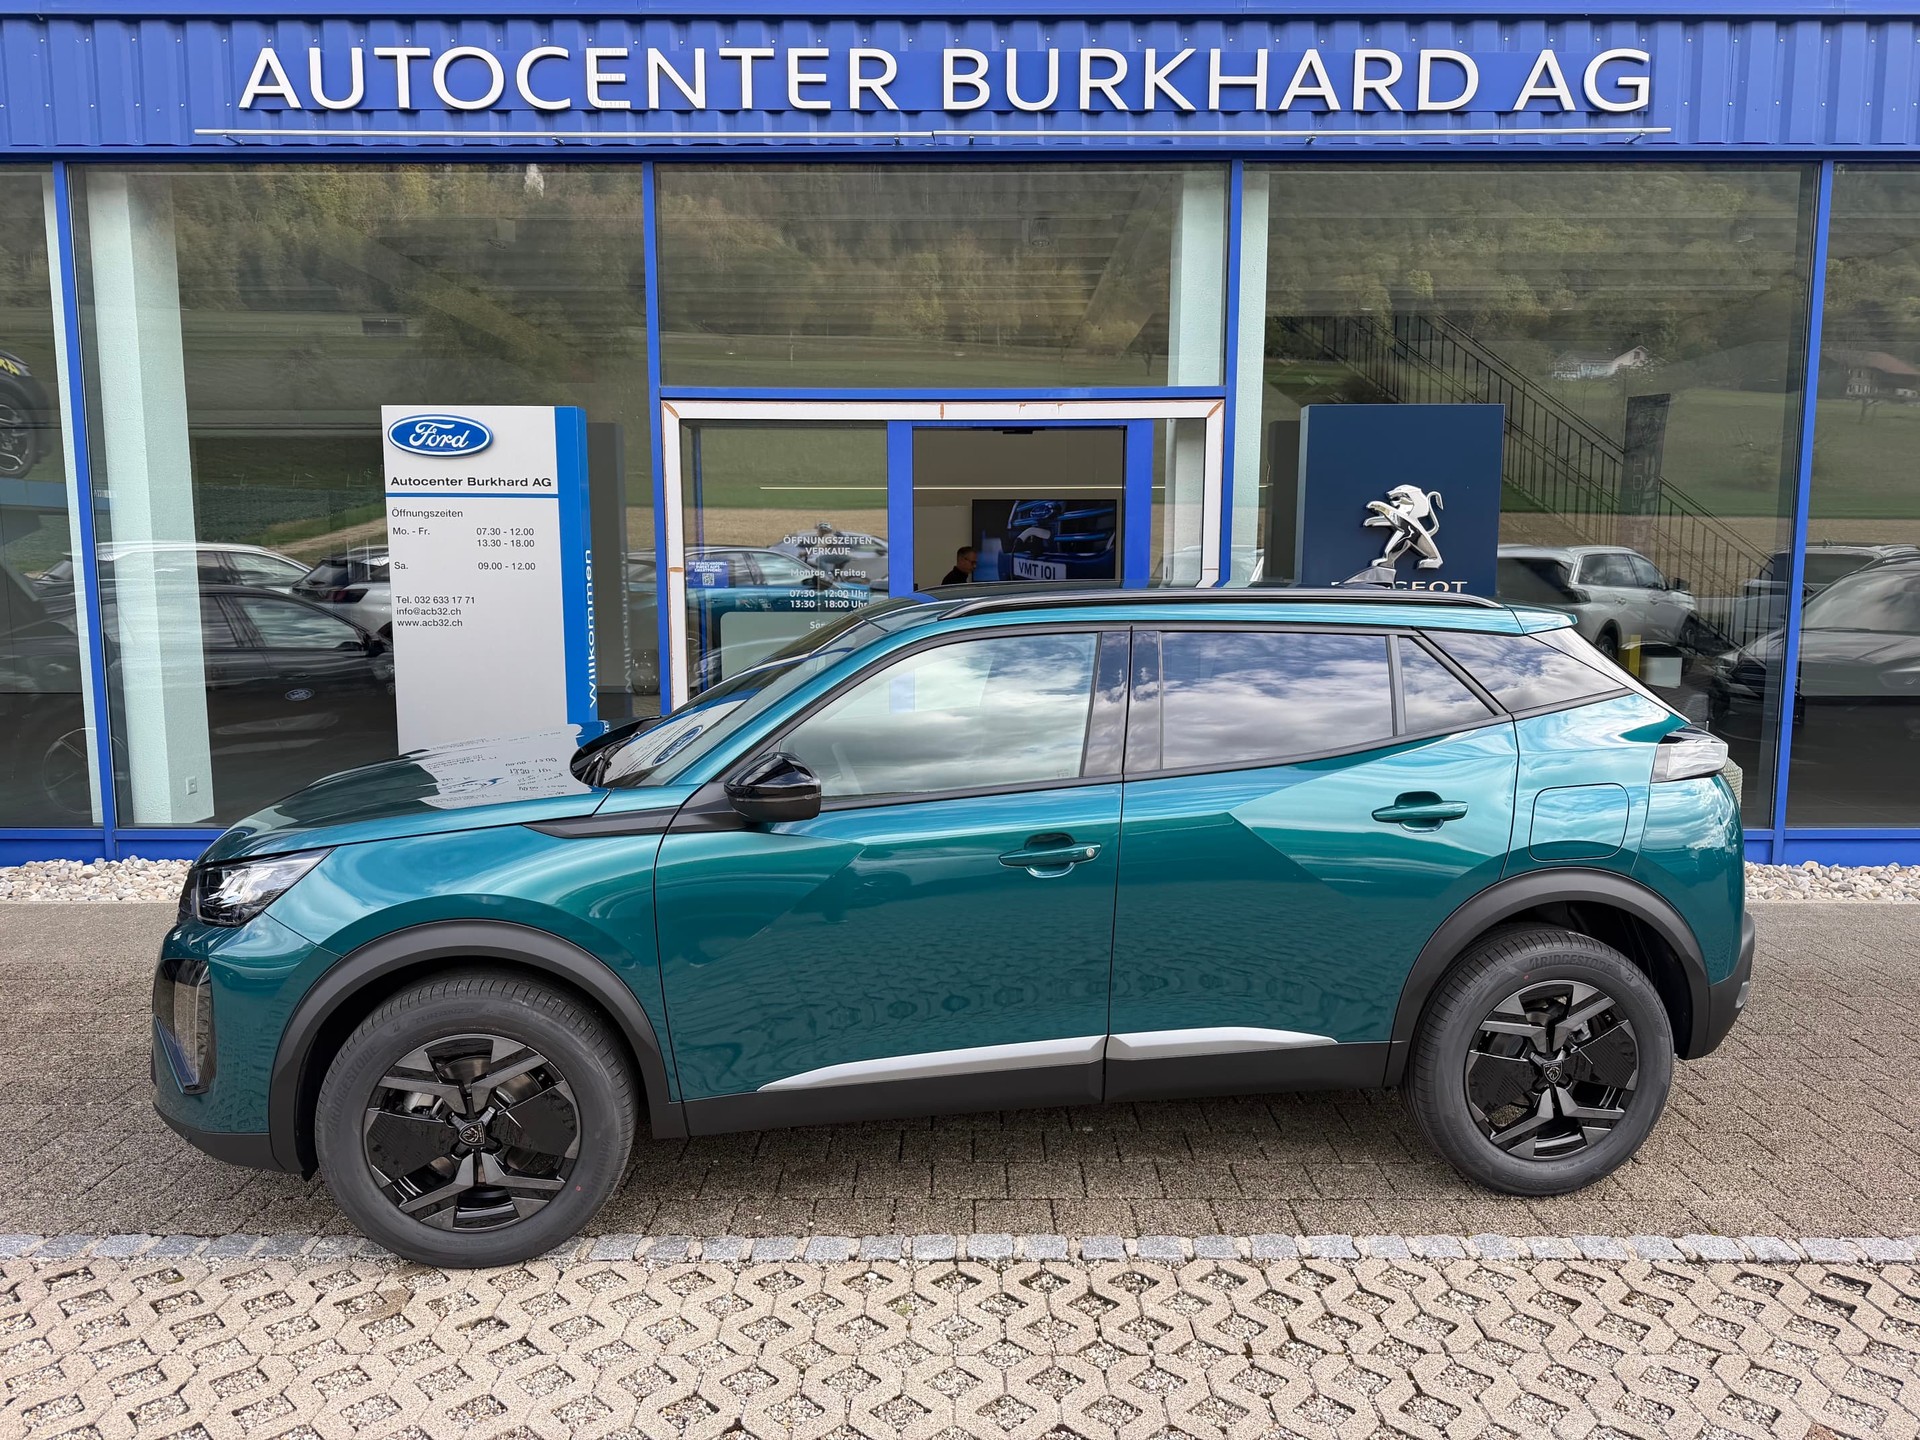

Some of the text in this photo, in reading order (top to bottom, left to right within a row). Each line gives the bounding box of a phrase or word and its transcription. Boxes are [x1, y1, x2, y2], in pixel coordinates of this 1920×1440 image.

[238, 46, 1652, 112] AUTOCENTER BURKHARD AG
[408, 421, 471, 448] Ford
[390, 476, 552, 487] Autocenter Burkhard AG
[391, 506, 464, 520] Öffnungszeiten
[392, 527, 410, 536] Mo.
[418, 527, 431, 536] Fr.
[476, 527, 501, 536] 07.30
[510, 527, 535, 536] 12.00
[477, 539, 502, 548] 13.30
[510, 539, 535, 548] 18.00
[783, 534, 872, 545] ÖFFNUNGSZEITEN
[805, 547, 851, 555] VERKAUF
[394, 561, 409, 570] Sa.
[477, 562, 503, 571] 09.00
[511, 562, 536, 571] 12.00
[1018, 561, 1039, 577] VMT
[790, 568, 826, 578] Montag
[834, 568, 866, 578] Freitag
[789, 589, 816, 598] 07:30
[825, 589, 849, 598] 12:00
[851, 589, 868, 598] Uhr
[395, 595, 476, 604] Tel. 032 633 17 71
[790, 600, 816, 608] 13:30
[825, 600, 849, 608] 18:00
[851, 600, 868, 608] Uhr
[396, 607, 462, 616] info@acb32.ch
[396, 618, 463, 627] www.acb32.ch
[585, 549, 599, 709] Willkommen
